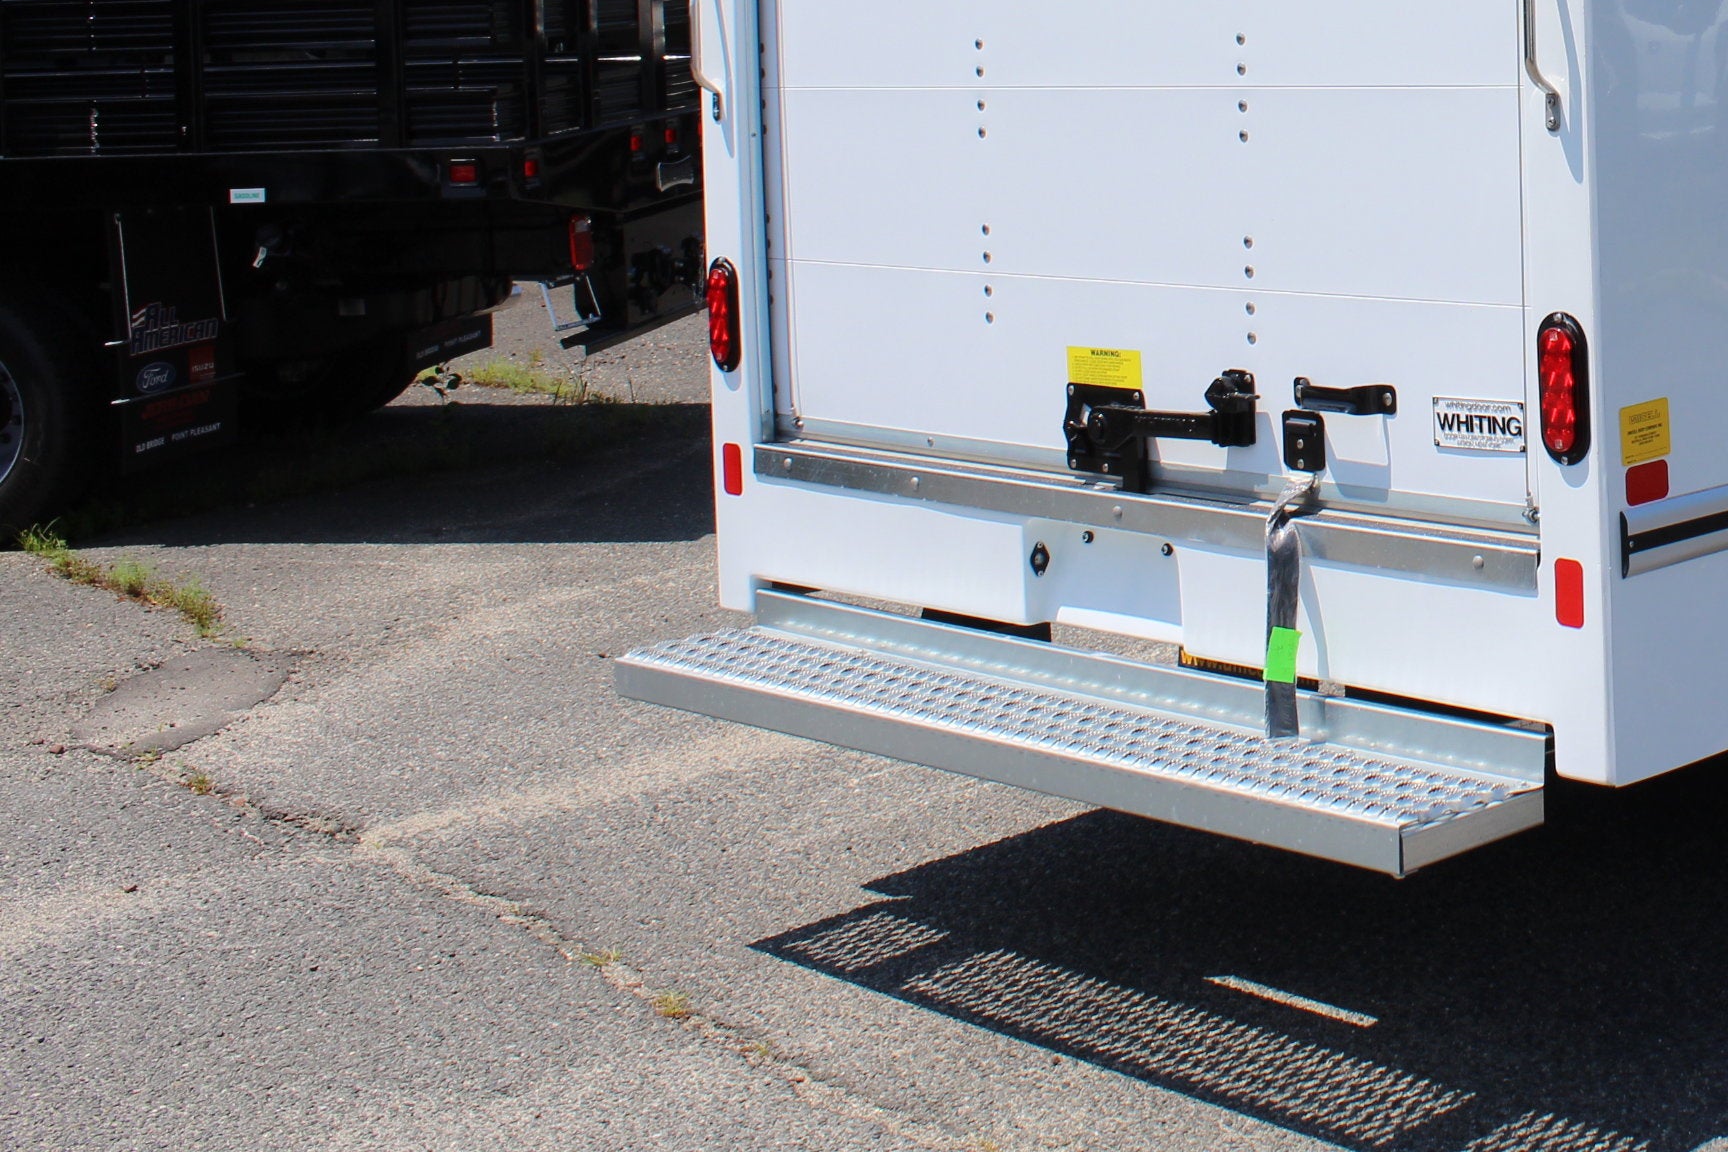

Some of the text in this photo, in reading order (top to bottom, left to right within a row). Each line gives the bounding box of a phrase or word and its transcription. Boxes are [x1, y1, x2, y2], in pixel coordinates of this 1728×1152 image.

[130, 318, 218, 355] AMERICAN
[142, 367, 169, 389] Ford
[1436, 411, 1522, 436] WHITING
